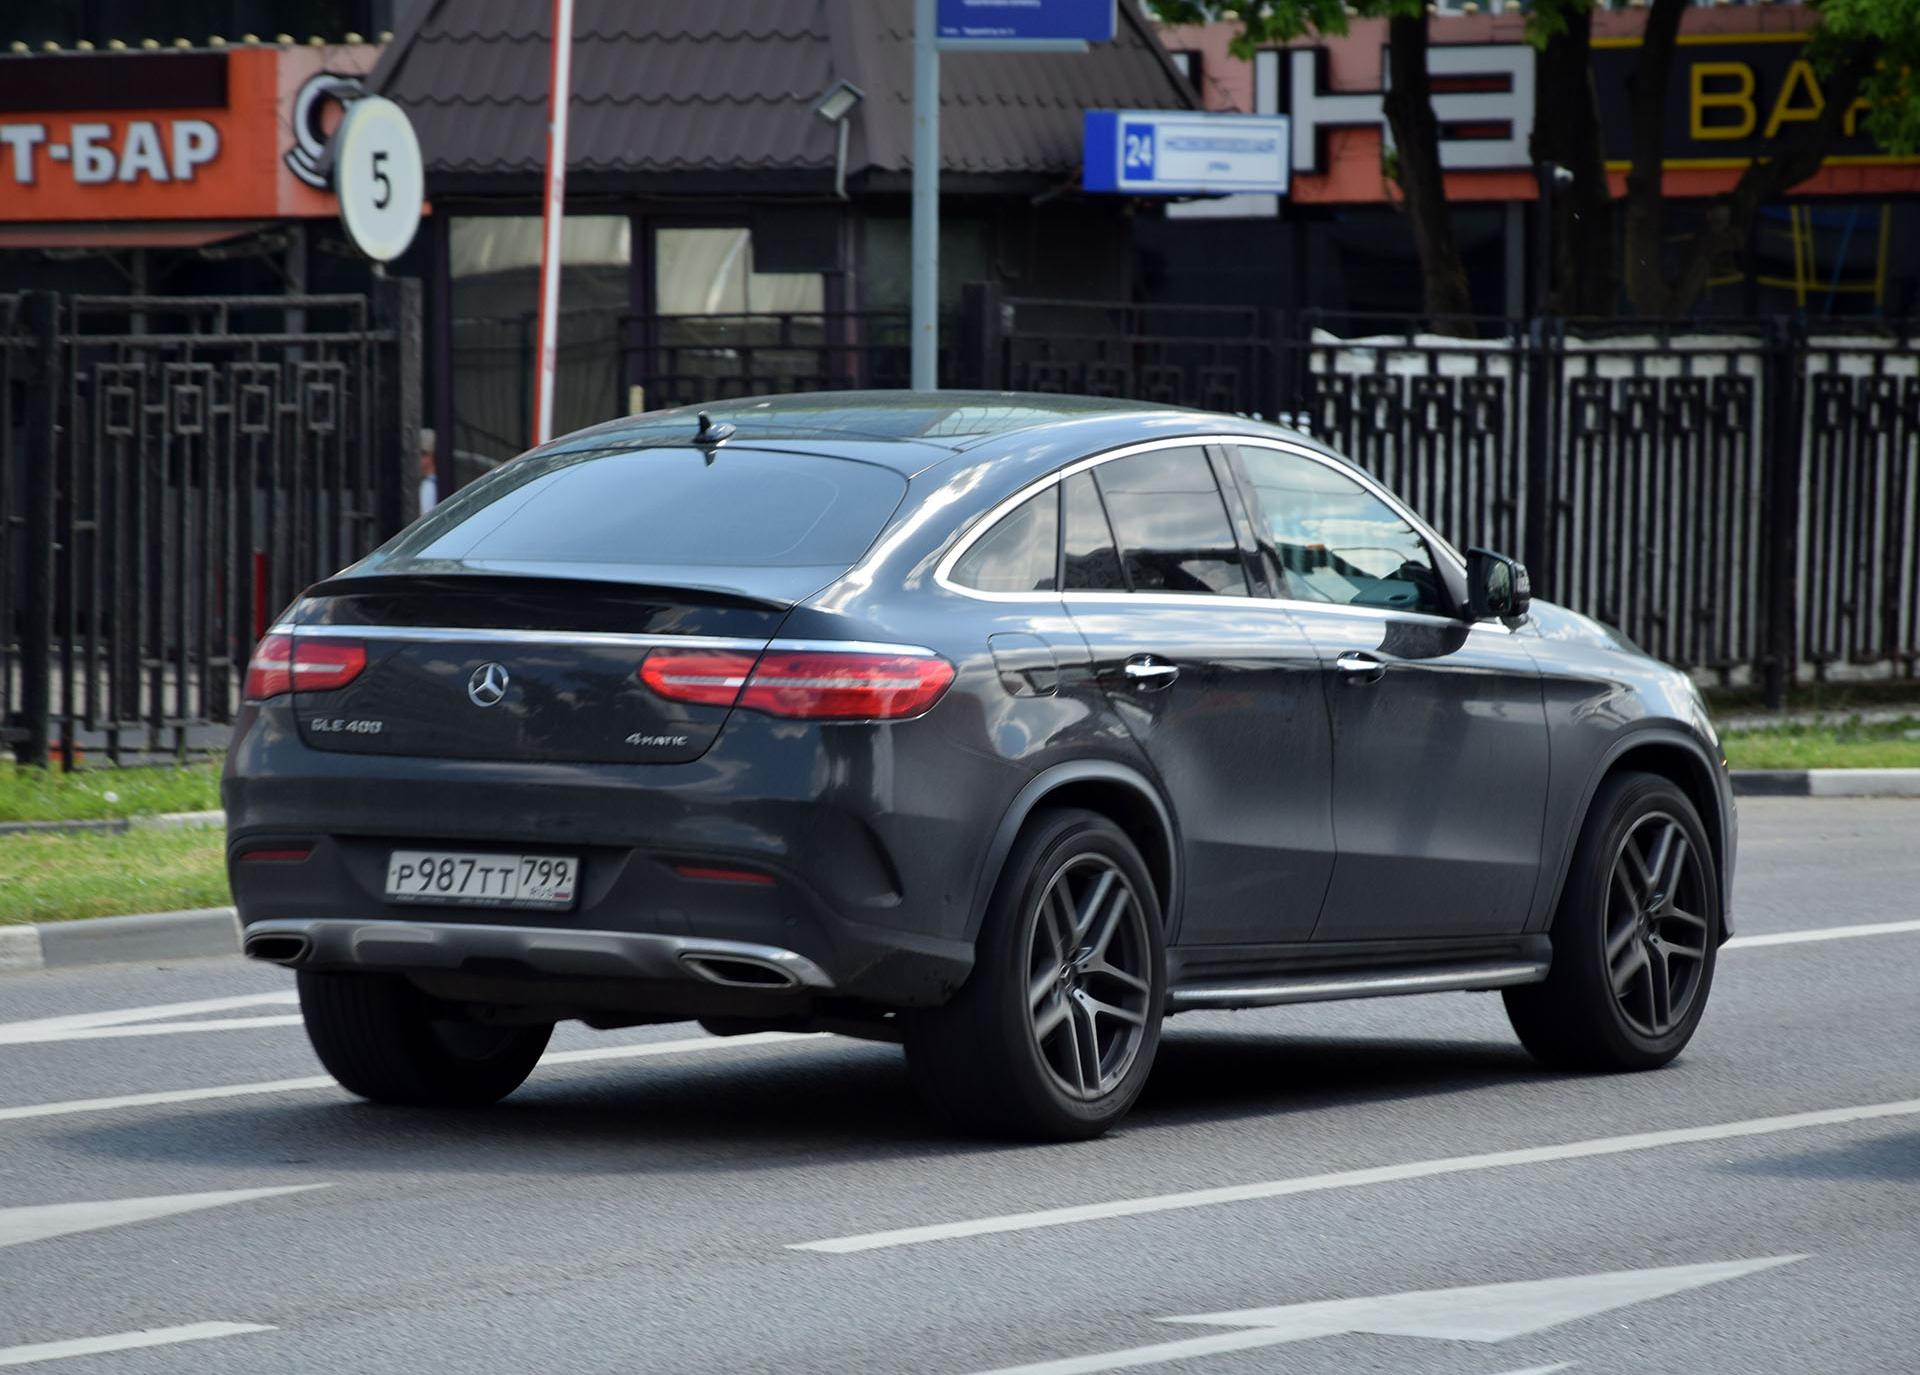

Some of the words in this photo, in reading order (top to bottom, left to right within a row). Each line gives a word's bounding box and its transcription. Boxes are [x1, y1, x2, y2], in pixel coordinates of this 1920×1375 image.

[1125, 133, 1153, 168] 24
[372, 151, 392, 210] 5
[311, 719, 344, 732] GLE
[345, 720, 383, 734] 400
[523, 859, 568, 887] 799
